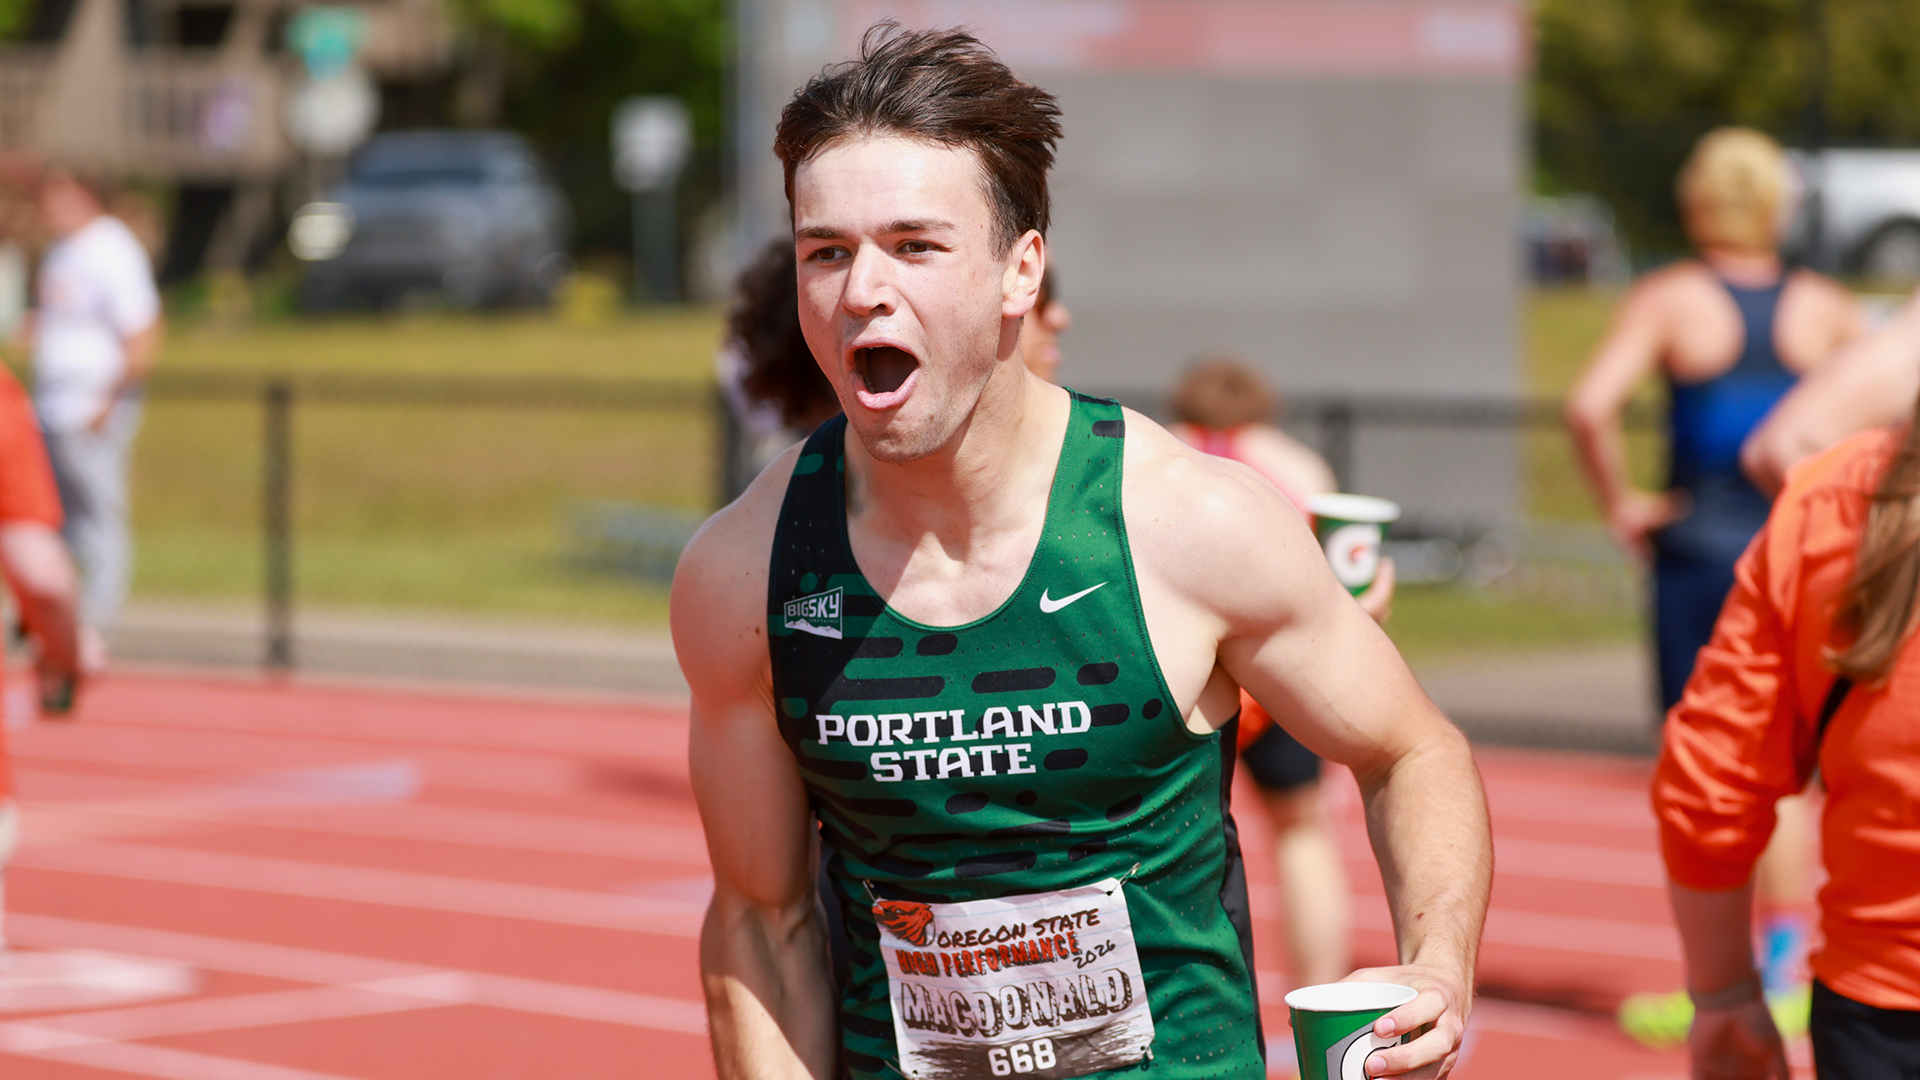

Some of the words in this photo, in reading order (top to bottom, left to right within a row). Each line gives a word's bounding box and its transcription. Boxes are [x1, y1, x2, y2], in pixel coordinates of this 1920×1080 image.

[815, 700, 1092, 746] PORTLAND
[870, 743, 1037, 782] STATE
[937, 922, 1026, 949] OREGON
[1033, 908, 1101, 936] STATE
[896, 949, 940, 977] HIGH
[941, 930, 1083, 978] PERFORMANCE
[1073, 939, 1116, 969] 2026
[900, 967, 1132, 1038] MACDONALD
[987, 1037, 1057, 1077] 668
